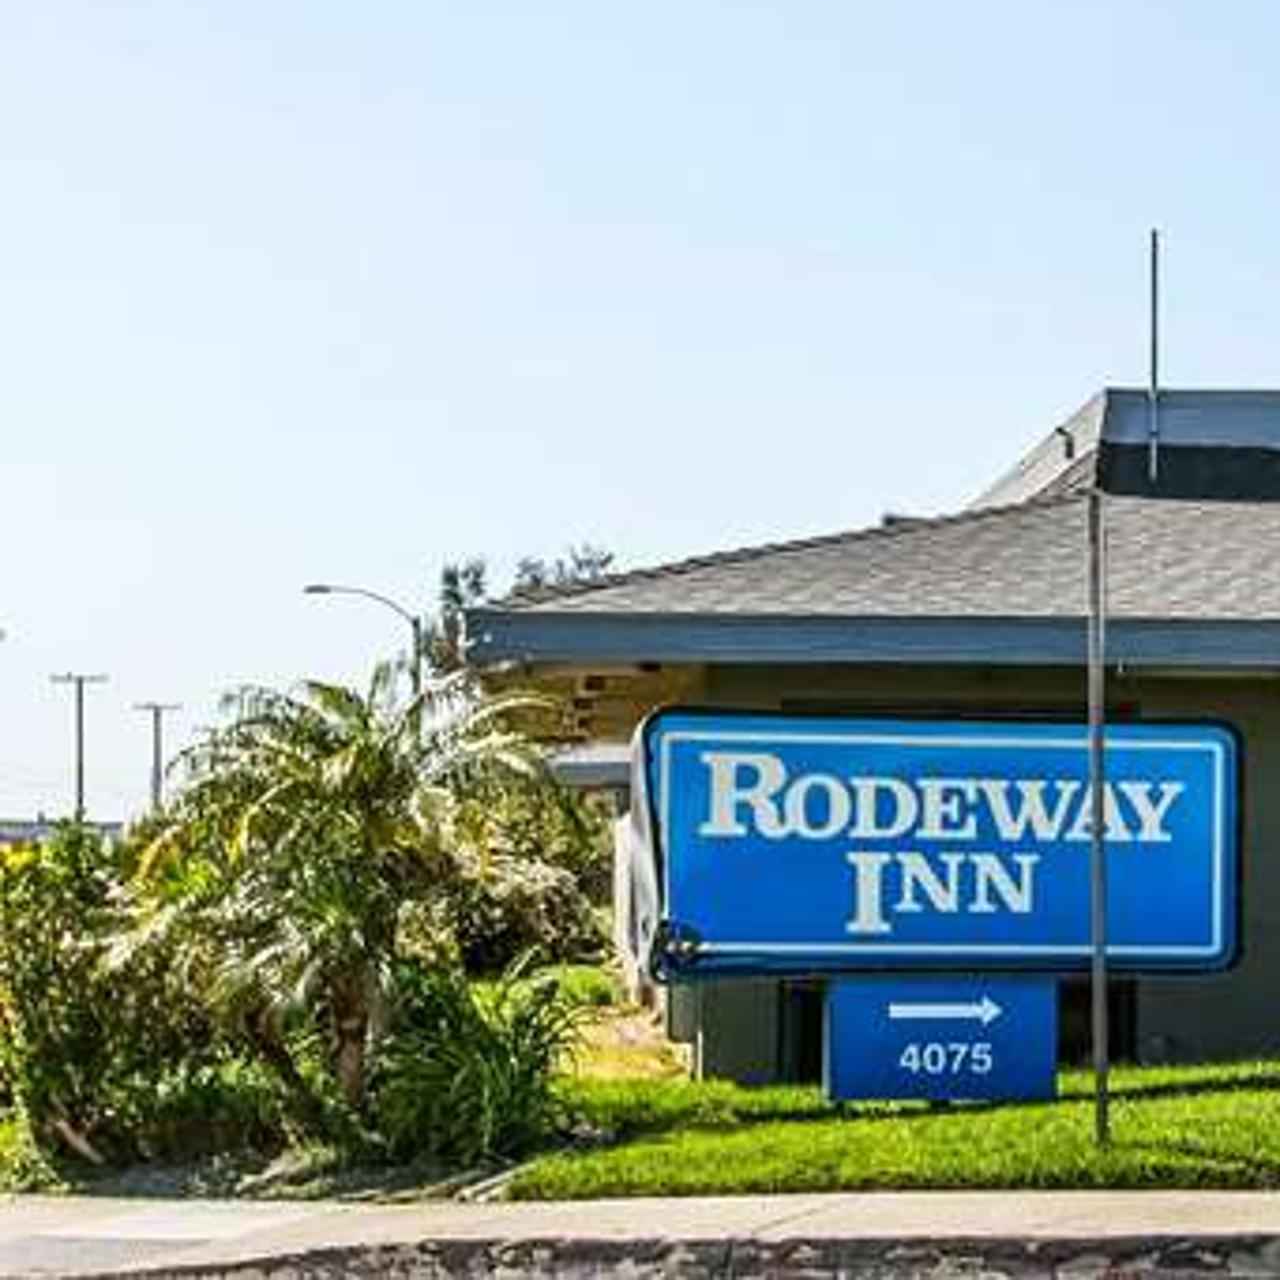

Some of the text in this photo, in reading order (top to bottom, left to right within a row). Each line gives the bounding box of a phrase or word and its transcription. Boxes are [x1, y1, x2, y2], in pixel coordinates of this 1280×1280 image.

[701, 752, 1185, 841] RODEWAY
[846, 852, 1038, 933] INN
[900, 1043, 993, 1075] 4075
